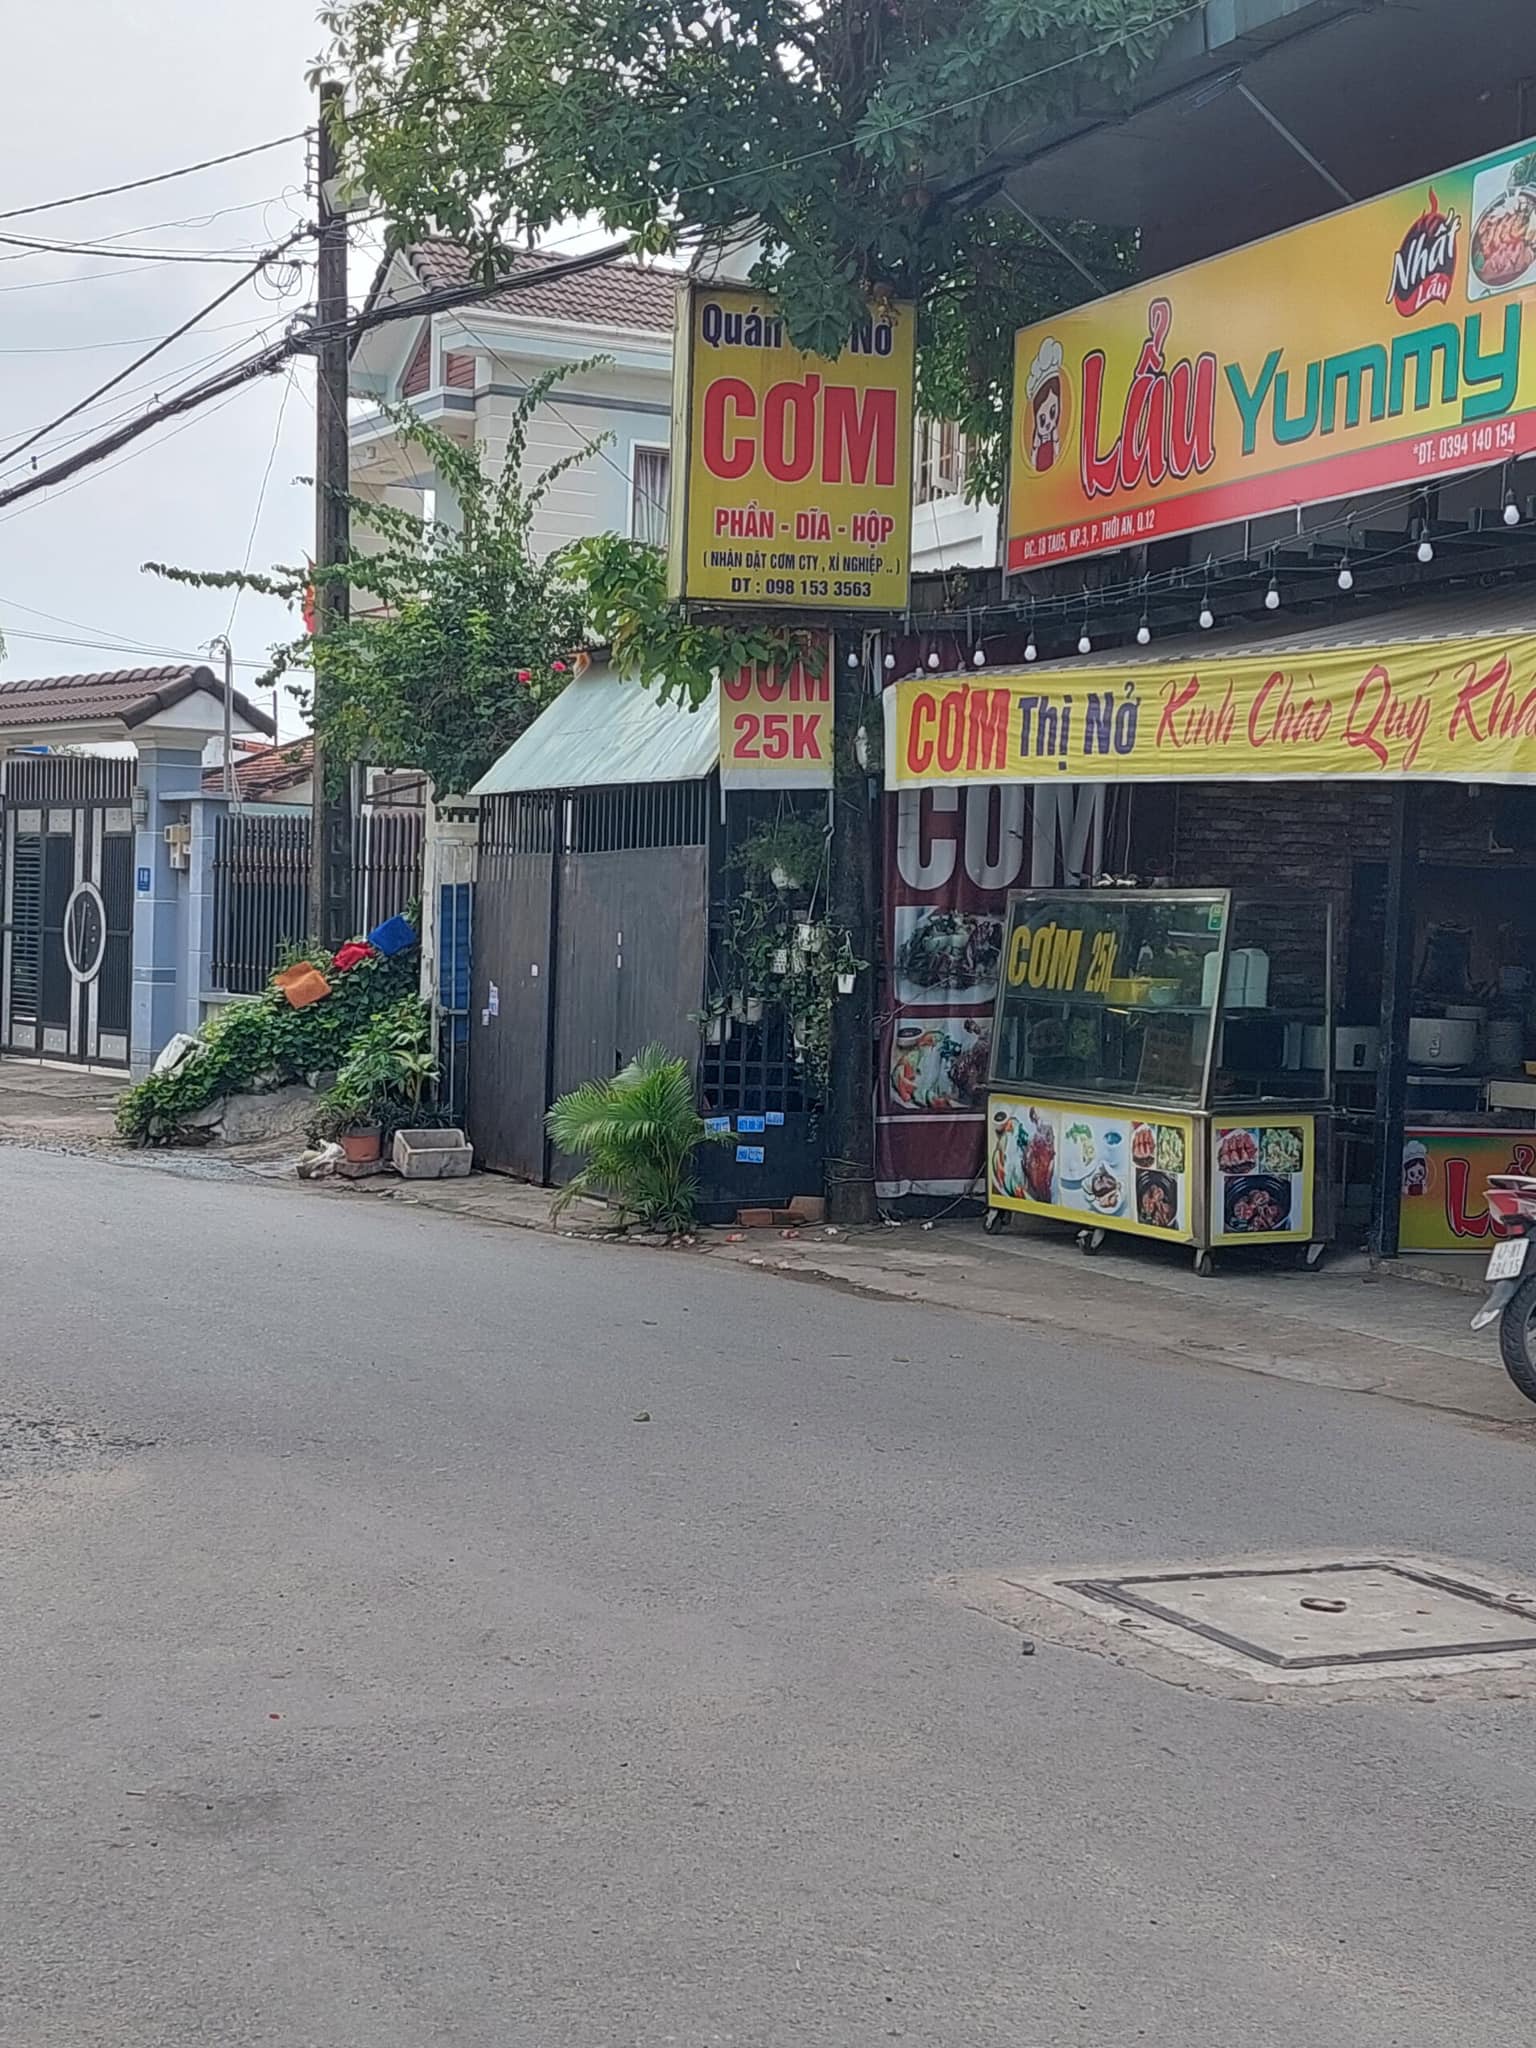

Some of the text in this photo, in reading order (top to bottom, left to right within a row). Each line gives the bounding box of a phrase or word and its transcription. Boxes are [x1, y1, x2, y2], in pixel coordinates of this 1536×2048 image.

[1386, 208, 1461, 303] Nhất
[703, 374, 897, 486] CƠM
[1080, 298, 1522, 499] Lẩu Yummy
[1439, 431, 1469, 460] 0394
[1471, 426, 1493, 453] 140
[1495, 421, 1516, 449] 154
[852, 509, 894, 549] HỘP
[766, 579, 794, 595] 098
[800, 580, 828, 597] 153
[833, 581, 872, 598] 3563
[733, 713, 822, 760] 25K
[906, 682, 1012, 774] CƠM
[1017, 694, 1073, 771] Thị
[1083, 681, 1142, 756] Nở
[1248, 670, 1333, 748] Chào
[1340, 663, 1440, 772] Quý
[1008, 922, 1083, 991] CƠM
